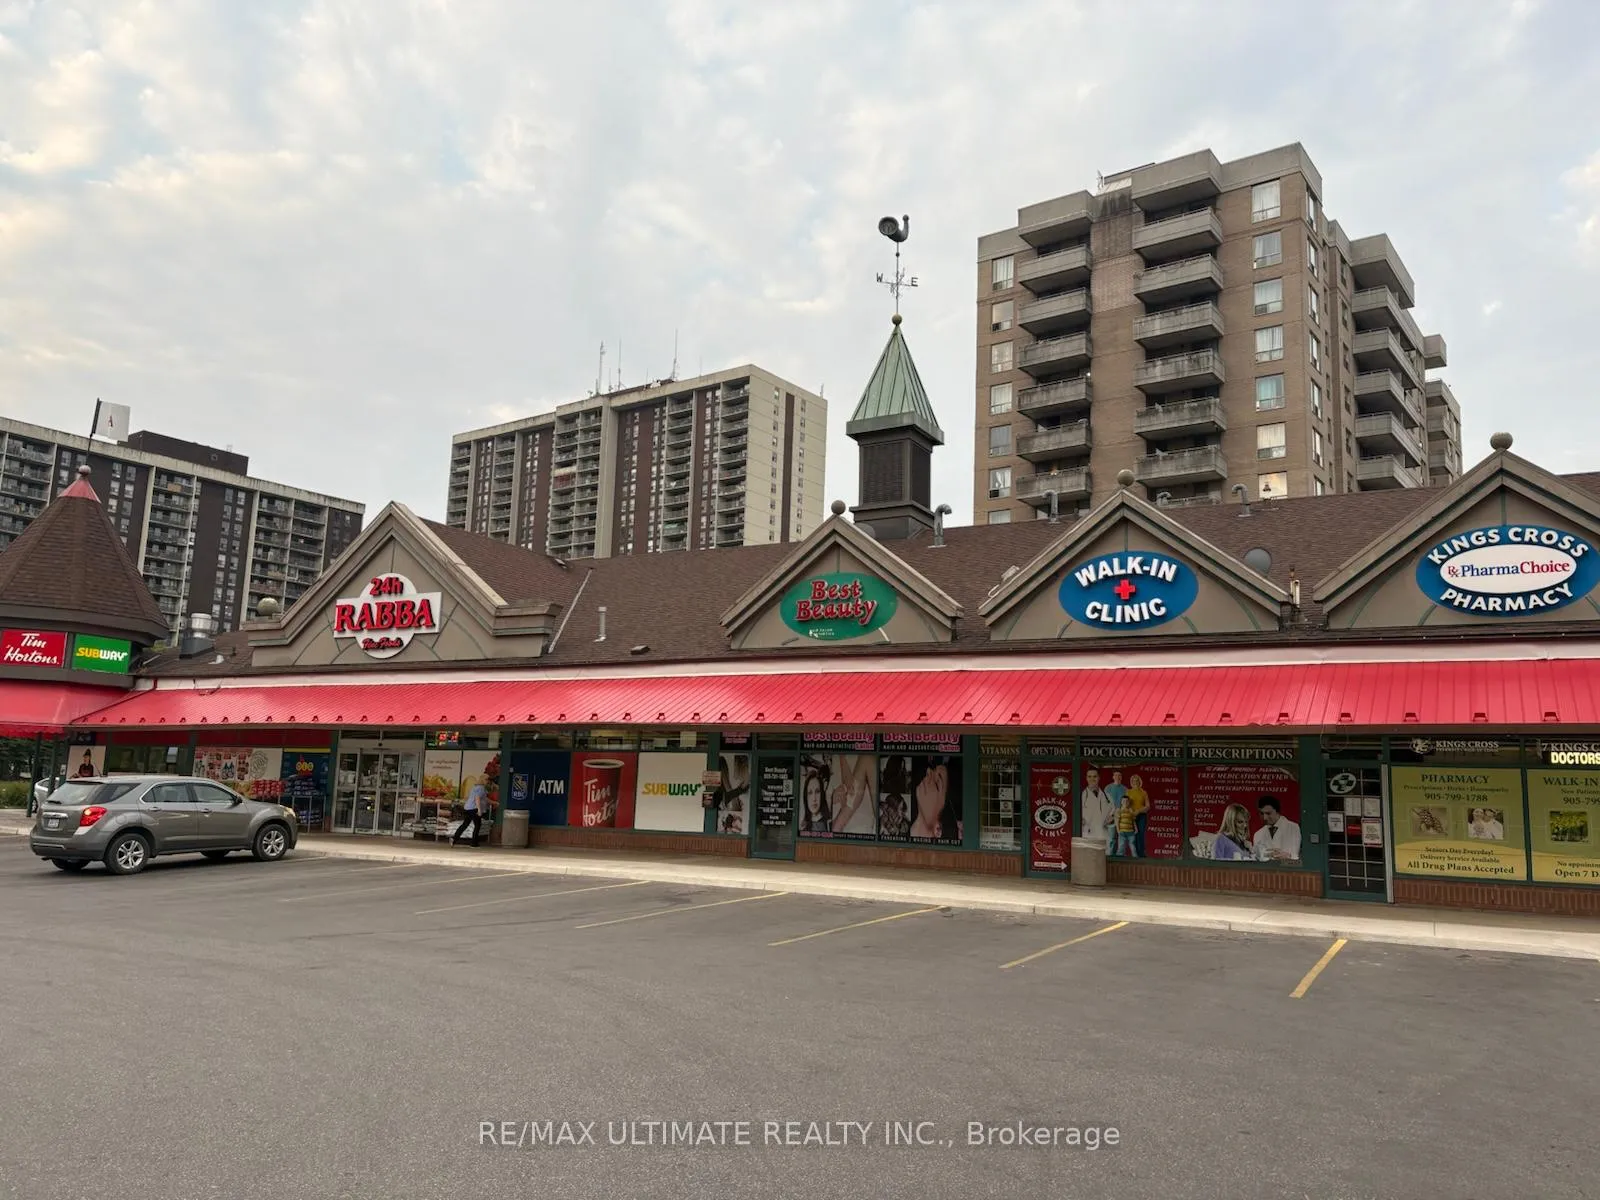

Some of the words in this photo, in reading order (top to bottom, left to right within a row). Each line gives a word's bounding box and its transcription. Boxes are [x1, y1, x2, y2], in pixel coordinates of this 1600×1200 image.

[1427, 529, 1500, 565] KINGS
[1508, 527, 1589, 558] CROSS
[1074, 556, 1177, 588] WALK-IN
[1461, 560, 1570, 577] PharmaChoice
[369, 577, 403, 596] 24h
[811, 579, 863, 600] Best
[1440, 582, 1574, 612] PHARMACY
[334, 599, 435, 632] RABBA
[796, 599, 877, 625] Beauty
[1085, 598, 1167, 623] CLINIC
[21, 632, 47, 648] Tim
[76, 647, 128, 662] SUBWAY
[981, 746, 1020, 755] VITAMINS
[1083, 747, 1137, 757] DOCTORS
[1139, 747, 1181, 758] OFFICE
[1436, 741, 1464, 749] KINGS
[1465, 741, 1499, 749] CROSS
[1551, 743, 1589, 751] KINGS
[1191, 748, 1293, 760] PRESCRIPTIONS
[1421, 774, 1491, 784] PHARMACY
[1543, 776, 1599, 786] WALK-IN
[537, 780, 564, 795] ATM
[584, 778, 610, 803] Tim
[642, 783, 702, 796] SUBWAY
[1034, 796, 1067, 808] WALK-IN
[1034, 826, 1067, 838] CLINIC
[1422, 862, 1445, 871] Drug
[1447, 863, 1472, 872] Plans
[1473, 865, 1515, 874] Accepted
[1555, 869, 1581, 878] Open
